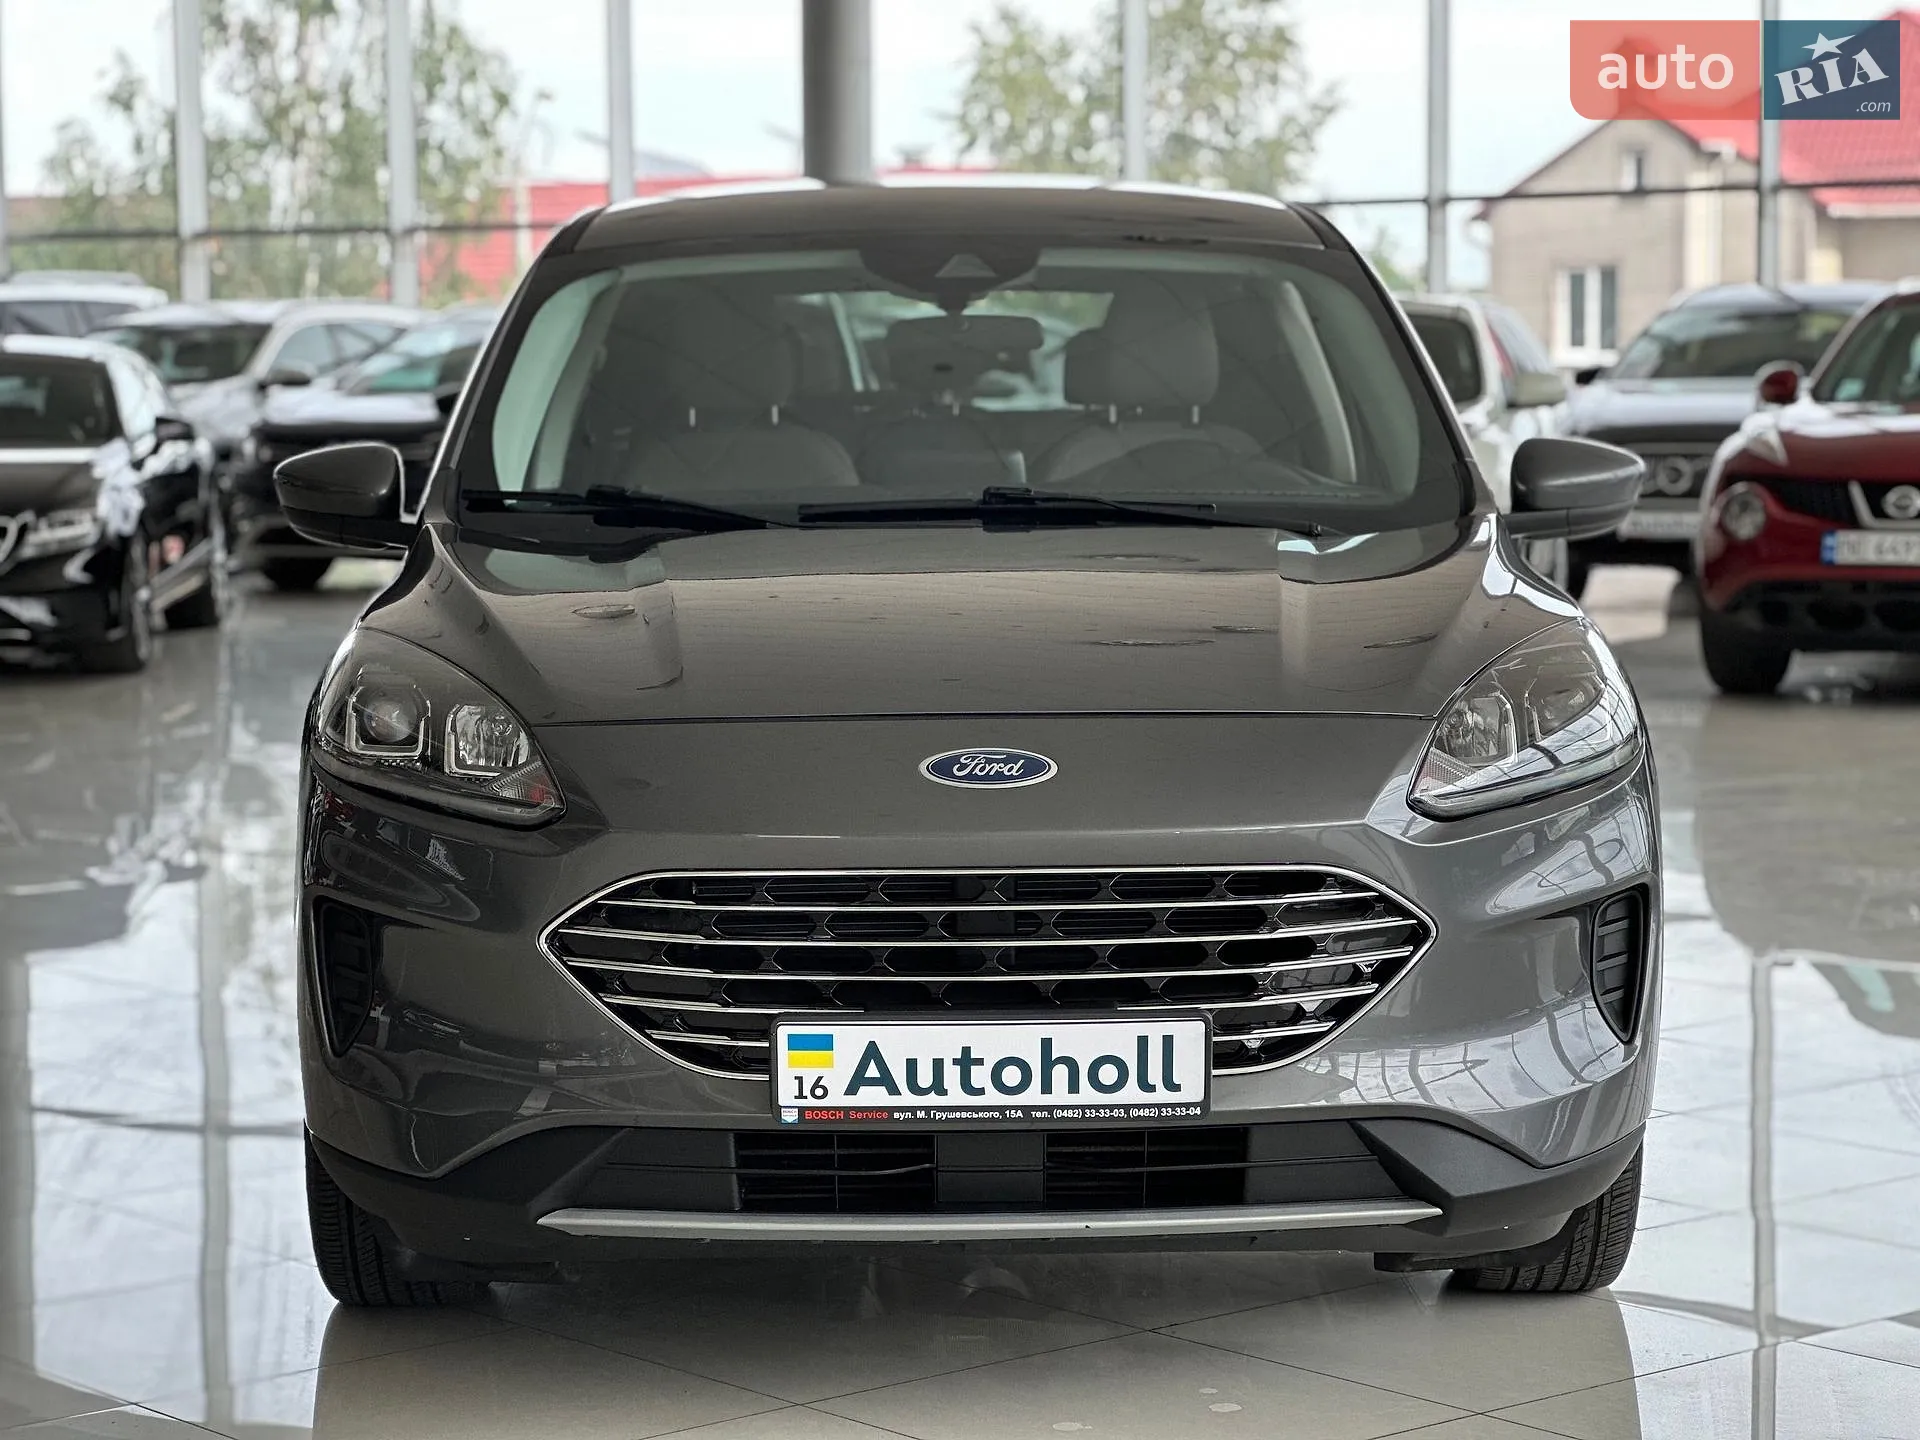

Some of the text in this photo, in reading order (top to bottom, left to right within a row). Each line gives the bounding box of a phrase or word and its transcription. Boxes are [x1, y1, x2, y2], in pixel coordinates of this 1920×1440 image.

[952, 753, 1024, 777] Ford
[843, 1035, 1181, 1096] Autoholl
[793, 1076, 829, 1100] 16
[804, 1110, 844, 1120] BOSCH
[849, 1110, 889, 1119] Service
[893, 1110, 914, 1121] вул.
[916, 1110, 928, 1119] М.
[930, 1110, 1002, 1121] Грушевського,
[1031, 1110, 1051, 1119] тел.
[1053, 1108, 1083, 1119] (0482)
[1084, 1108, 1128, 1119] 33-33-03,
[1129, 1107, 1159, 1118] (0482)
[1160, 1106, 1201, 1117] 33-33-04
